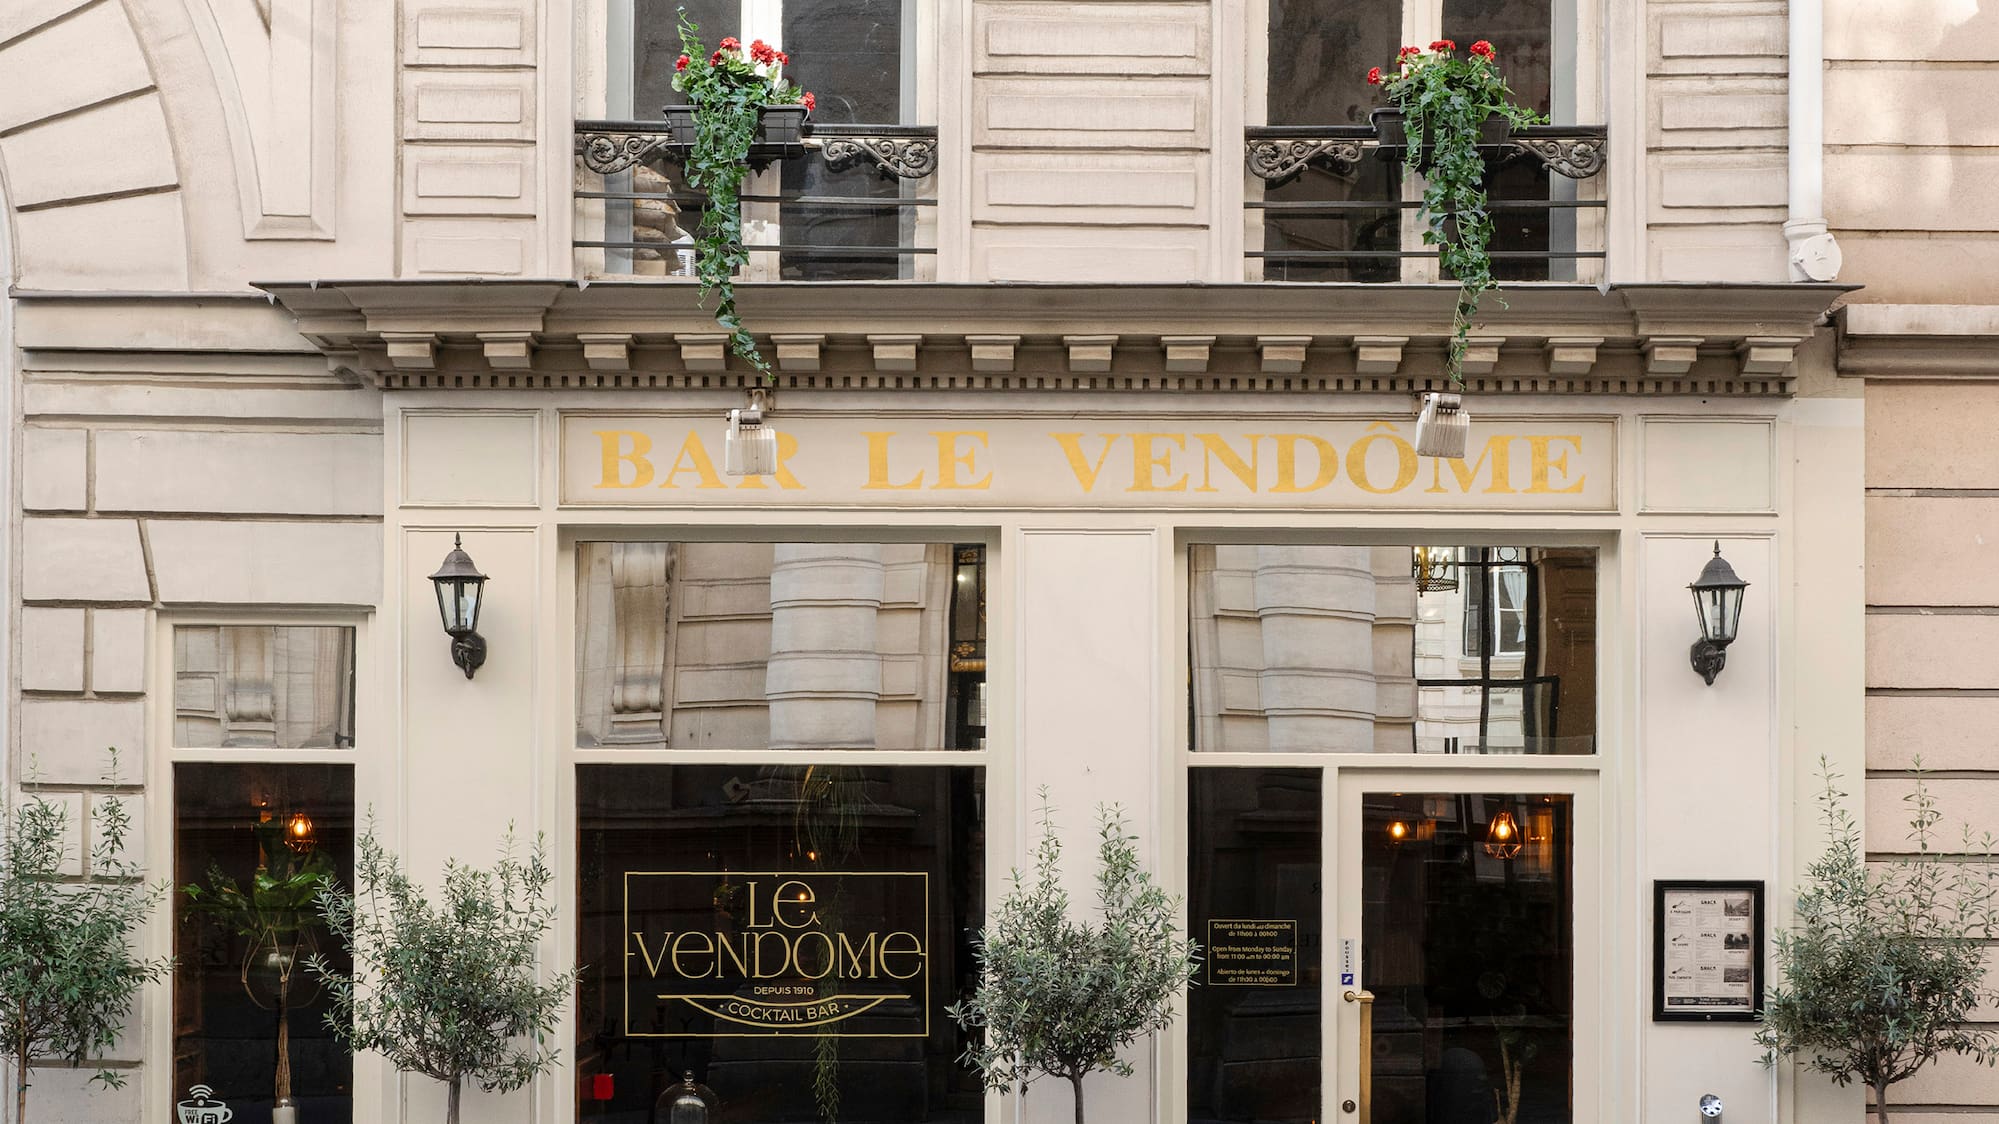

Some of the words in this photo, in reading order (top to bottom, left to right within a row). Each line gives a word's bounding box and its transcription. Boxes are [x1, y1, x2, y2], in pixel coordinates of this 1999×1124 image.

[593, 429, 807, 490] BAR
[860, 430, 995, 491] LE
[1048, 421, 1587, 495] VENDÔME
[1213, 922, 1233, 930] Ouvert
[1212, 945, 1227, 953] Open
[1242, 946, 1265, 954] Monday
[1272, 946, 1293, 954] Sunday
[1266, 968, 1290, 977] domingo
[753, 986, 792, 996] DEPUIS
[792, 986, 814, 996] 1910
[728, 1002, 803, 1022] COCKTAIL
[806, 1002, 840, 1021] BAR
